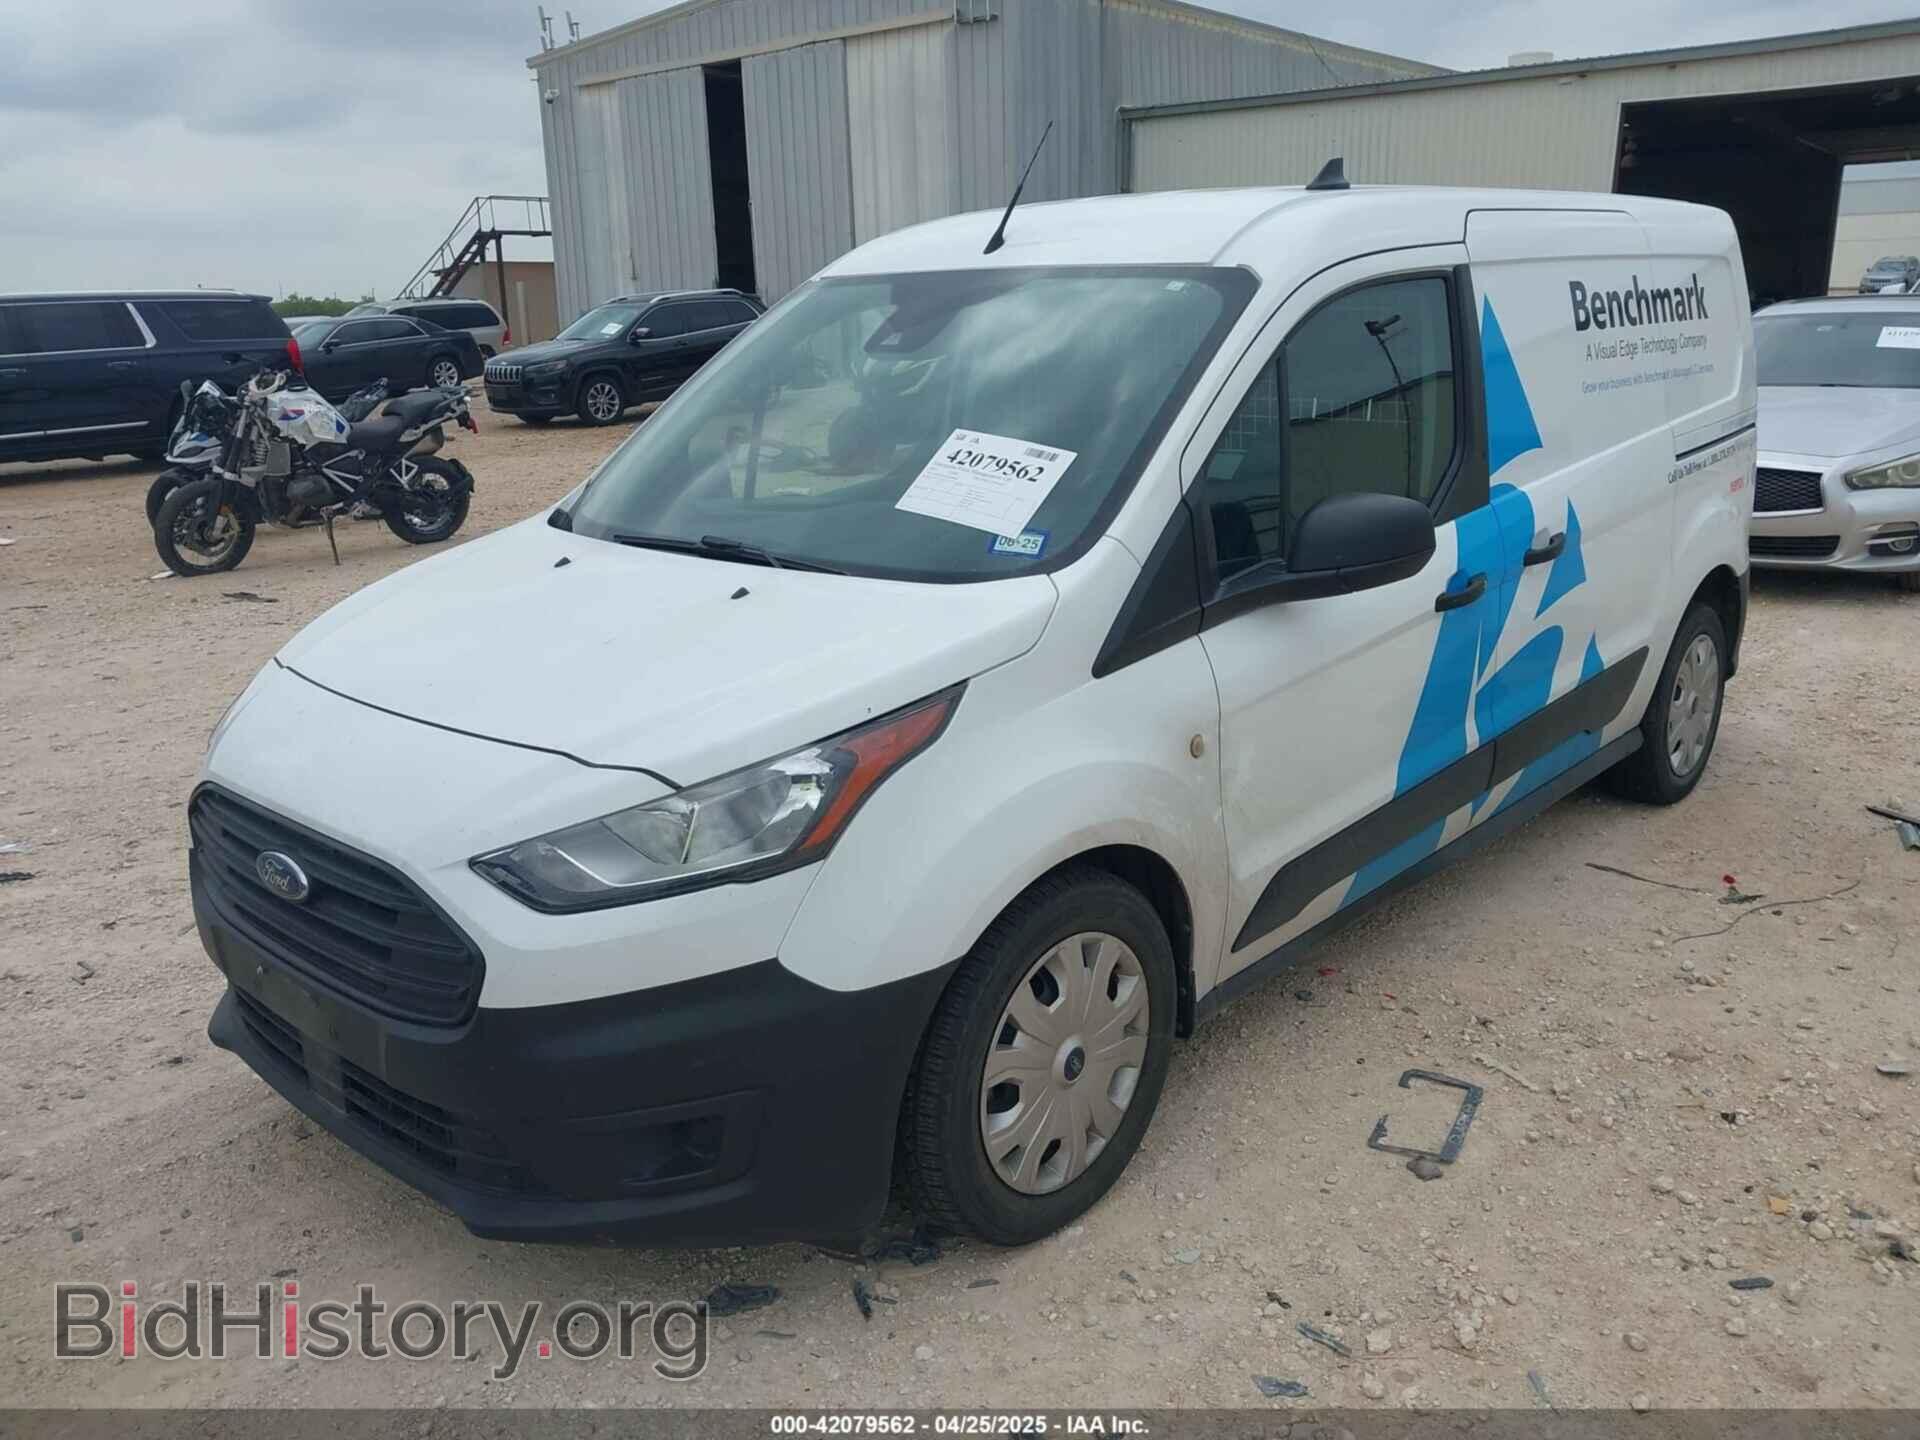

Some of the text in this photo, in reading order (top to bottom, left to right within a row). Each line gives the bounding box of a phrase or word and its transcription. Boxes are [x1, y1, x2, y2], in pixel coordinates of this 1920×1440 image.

[1569, 273, 1709, 331] Benchmark
[1585, 333, 1708, 361] A Visual Edge Technology Company
[946, 448, 1045, 482] 42079562
